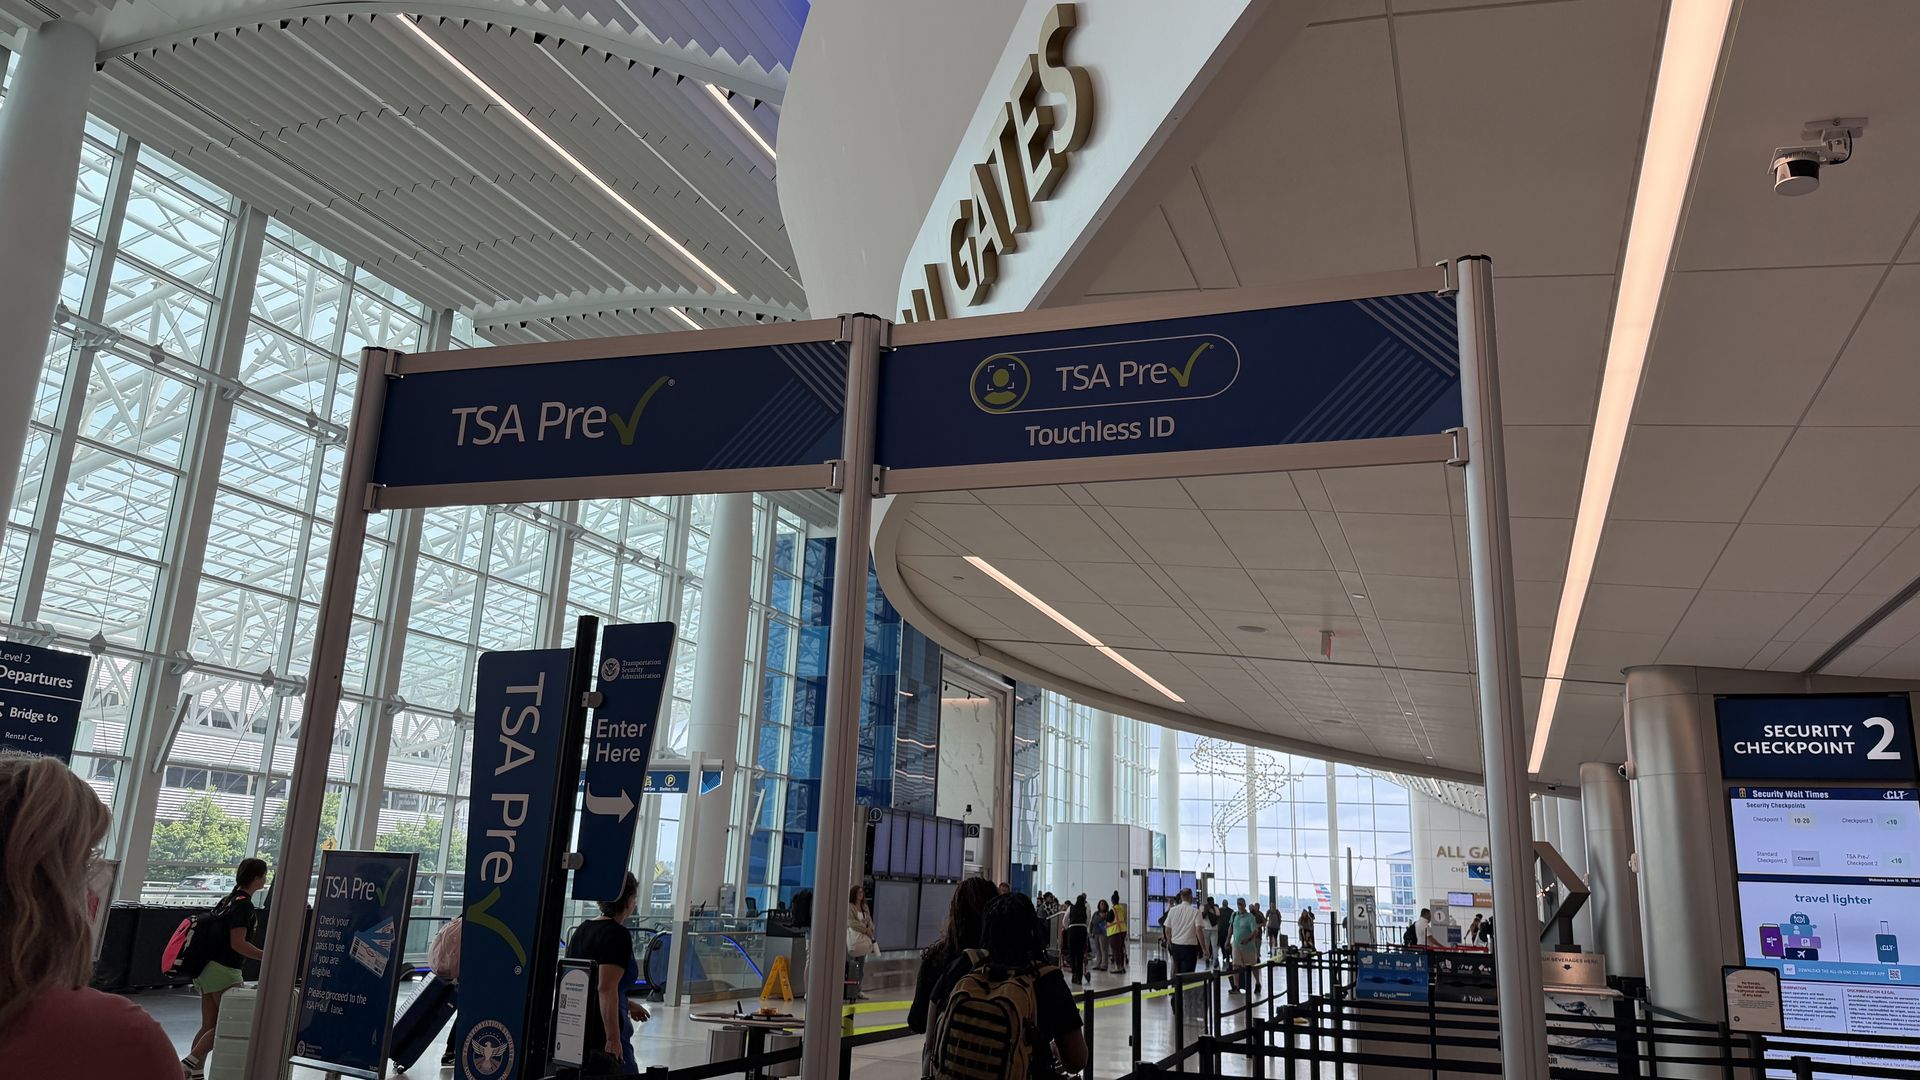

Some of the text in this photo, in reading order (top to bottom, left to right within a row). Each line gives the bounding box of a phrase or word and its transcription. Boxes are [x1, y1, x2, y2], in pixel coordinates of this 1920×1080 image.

[947, 2, 1094, 307] GATES
[1055, 362, 1110, 391] TSA
[452, 403, 525, 446] TSA
[1025, 415, 1175, 447] Touchless ID
[0, 650, 31, 664] Level 2
[0, 664, 73, 689] Departures
[9, 706, 58, 723] Bridge to
[494, 671, 546, 777] TSA
[596, 718, 647, 738] Enter
[5, 731, 43, 743] Rental Cars
[1763, 716, 1901, 760] SECURITY 2
[595, 742, 641, 763] Here
[1733, 741, 1855, 755] CHECKPOINT
[1752, 790, 1784, 799] Security
[1806, 791, 1829, 799] Times
[1883, 790, 1908, 800] CLT
[1436, 845, 1489, 859] ALL GA
[324, 875, 349, 900] TSA
[1794, 893, 1873, 907] travel lighter
[1358, 906, 1365, 918] 2
[320, 915, 350, 928] Check your
[318, 928, 342, 941] boarding
[316, 942, 345, 952] pass to see
[319, 956, 329, 965] you
[330, 956, 339, 965] are
[308, 987, 367, 1004] Please proceed to the
[330, 1004, 344, 1015] lane.
